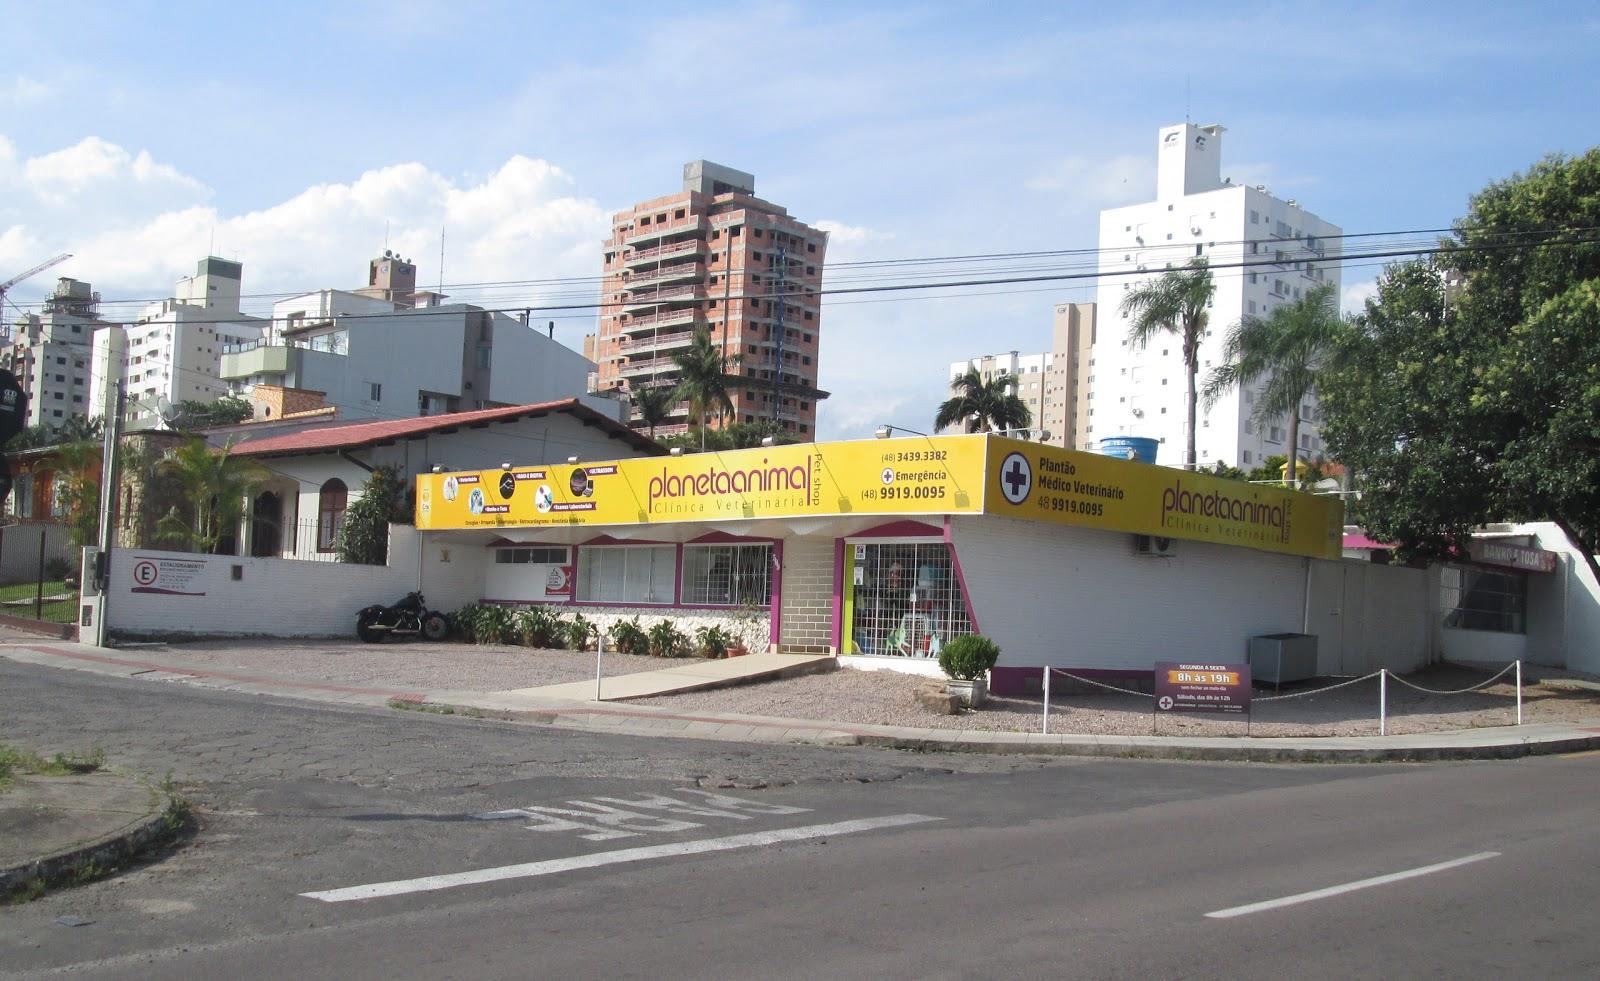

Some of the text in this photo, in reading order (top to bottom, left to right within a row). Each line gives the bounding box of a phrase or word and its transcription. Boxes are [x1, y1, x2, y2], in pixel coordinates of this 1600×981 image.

[882, 450, 947, 463] (48) 3439.3382
[1039, 456, 1076, 476] Plantão
[649, 454, 812, 514] planetaanimal
[895, 469, 947, 482] Emergência
[811, 477, 822, 506] shop
[861, 485, 946, 500] (48) 9919.0095
[1038, 475, 1125, 501] Médico Veterinário
[654, 496, 805, 514] Clínica Veterinária
[1051, 497, 1104, 517] 9919.0095
[1161, 479, 1286, 543] planetaanimal
[1520, 550, 1540, 567] TOSA
[141, 566, 151, 581] E
[1177, 672, 1192, 683] 8h
[1210, 673, 1231, 683] 19h
